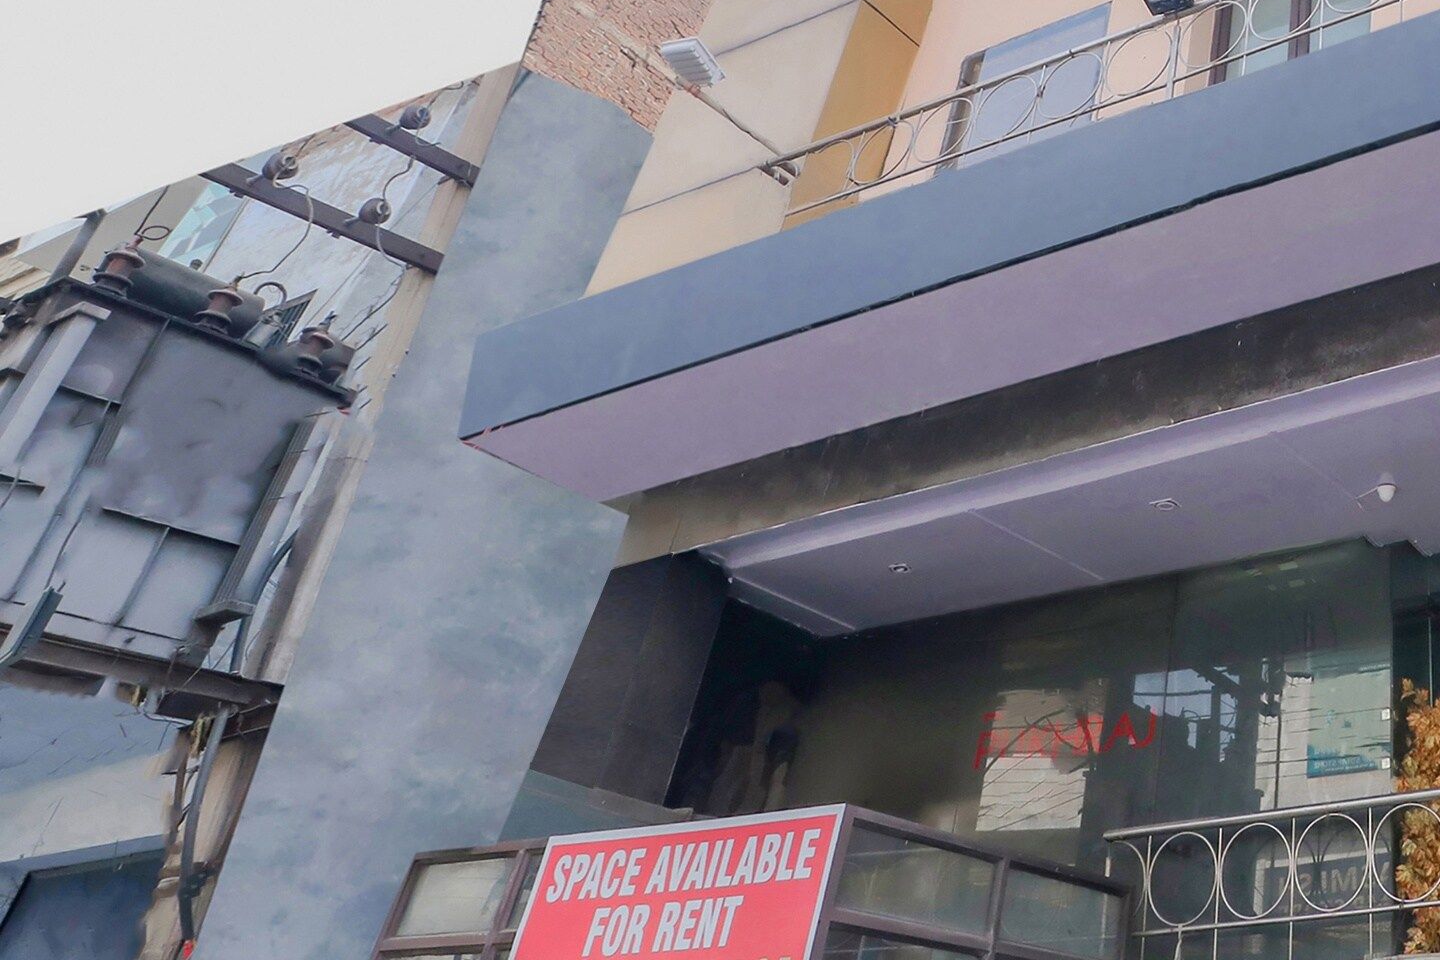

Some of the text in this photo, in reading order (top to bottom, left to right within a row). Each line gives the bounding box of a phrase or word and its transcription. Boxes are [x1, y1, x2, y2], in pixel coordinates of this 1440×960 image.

[546, 828, 821, 903] SPACE AVAILABLE
[581, 896, 744, 957] FOR RENT
